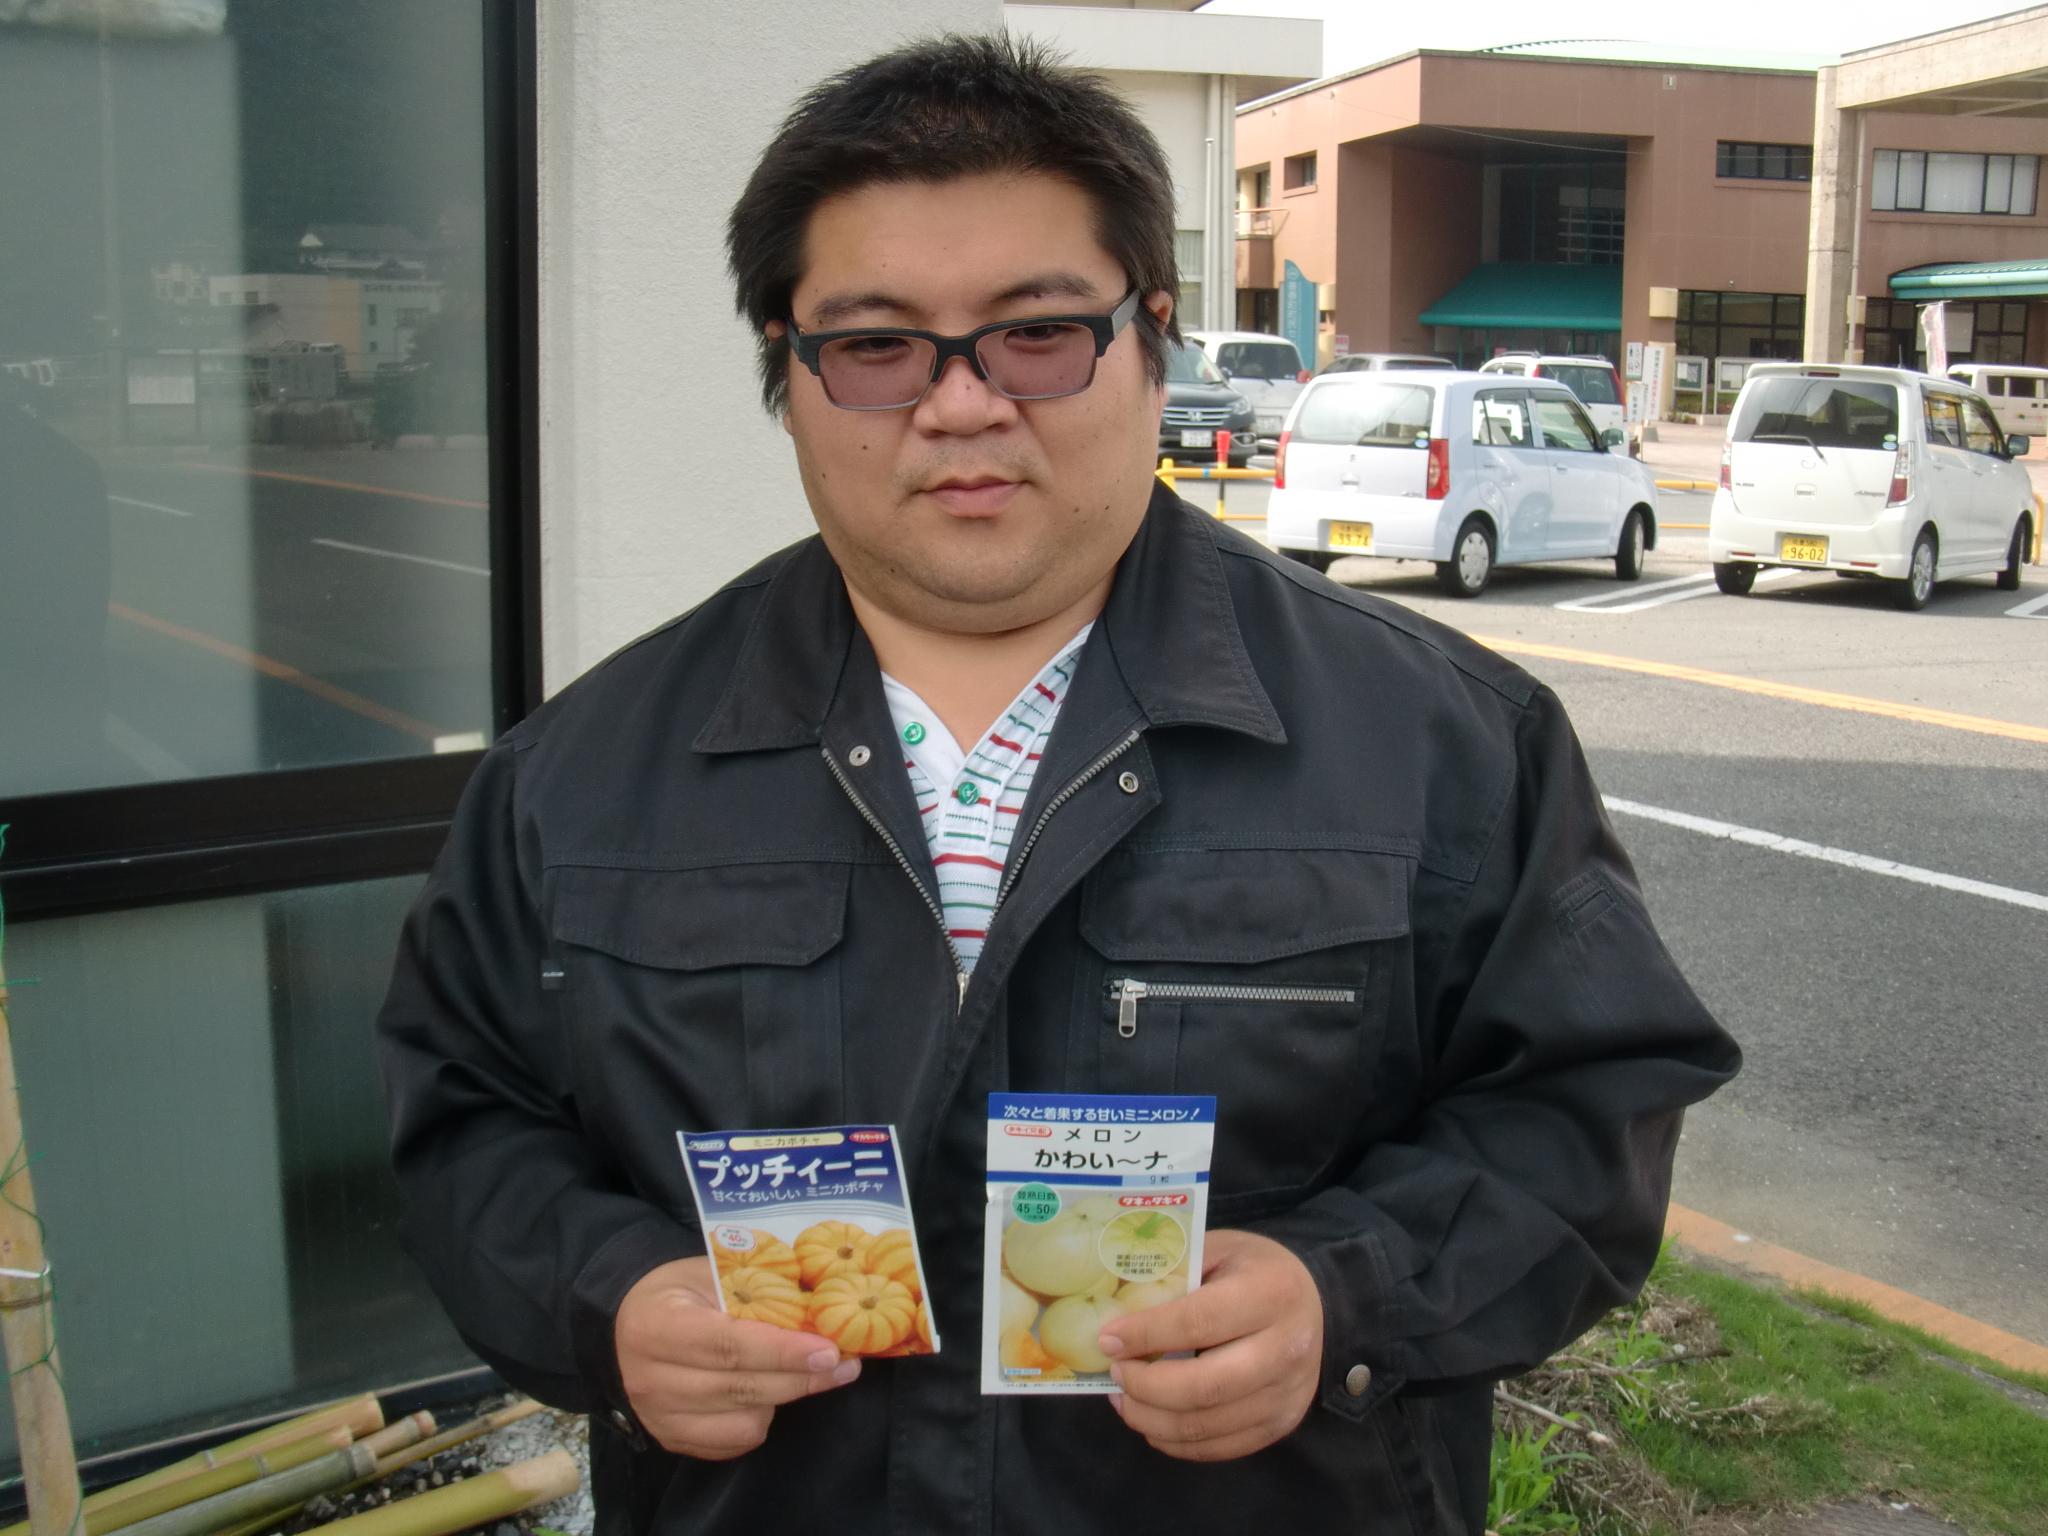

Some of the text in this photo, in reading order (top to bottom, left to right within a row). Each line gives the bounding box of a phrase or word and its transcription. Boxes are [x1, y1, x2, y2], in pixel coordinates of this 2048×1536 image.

[1790, 546, 1825, 562] 96-02
[752, 1136, 821, 1148] ミニカボチャ
[1064, 1127, 1142, 1143] メロン
[697, 1150, 889, 1189] プッチィーニ
[711, 1181, 884, 1203] 甘くておいしい ミニカボチャ
